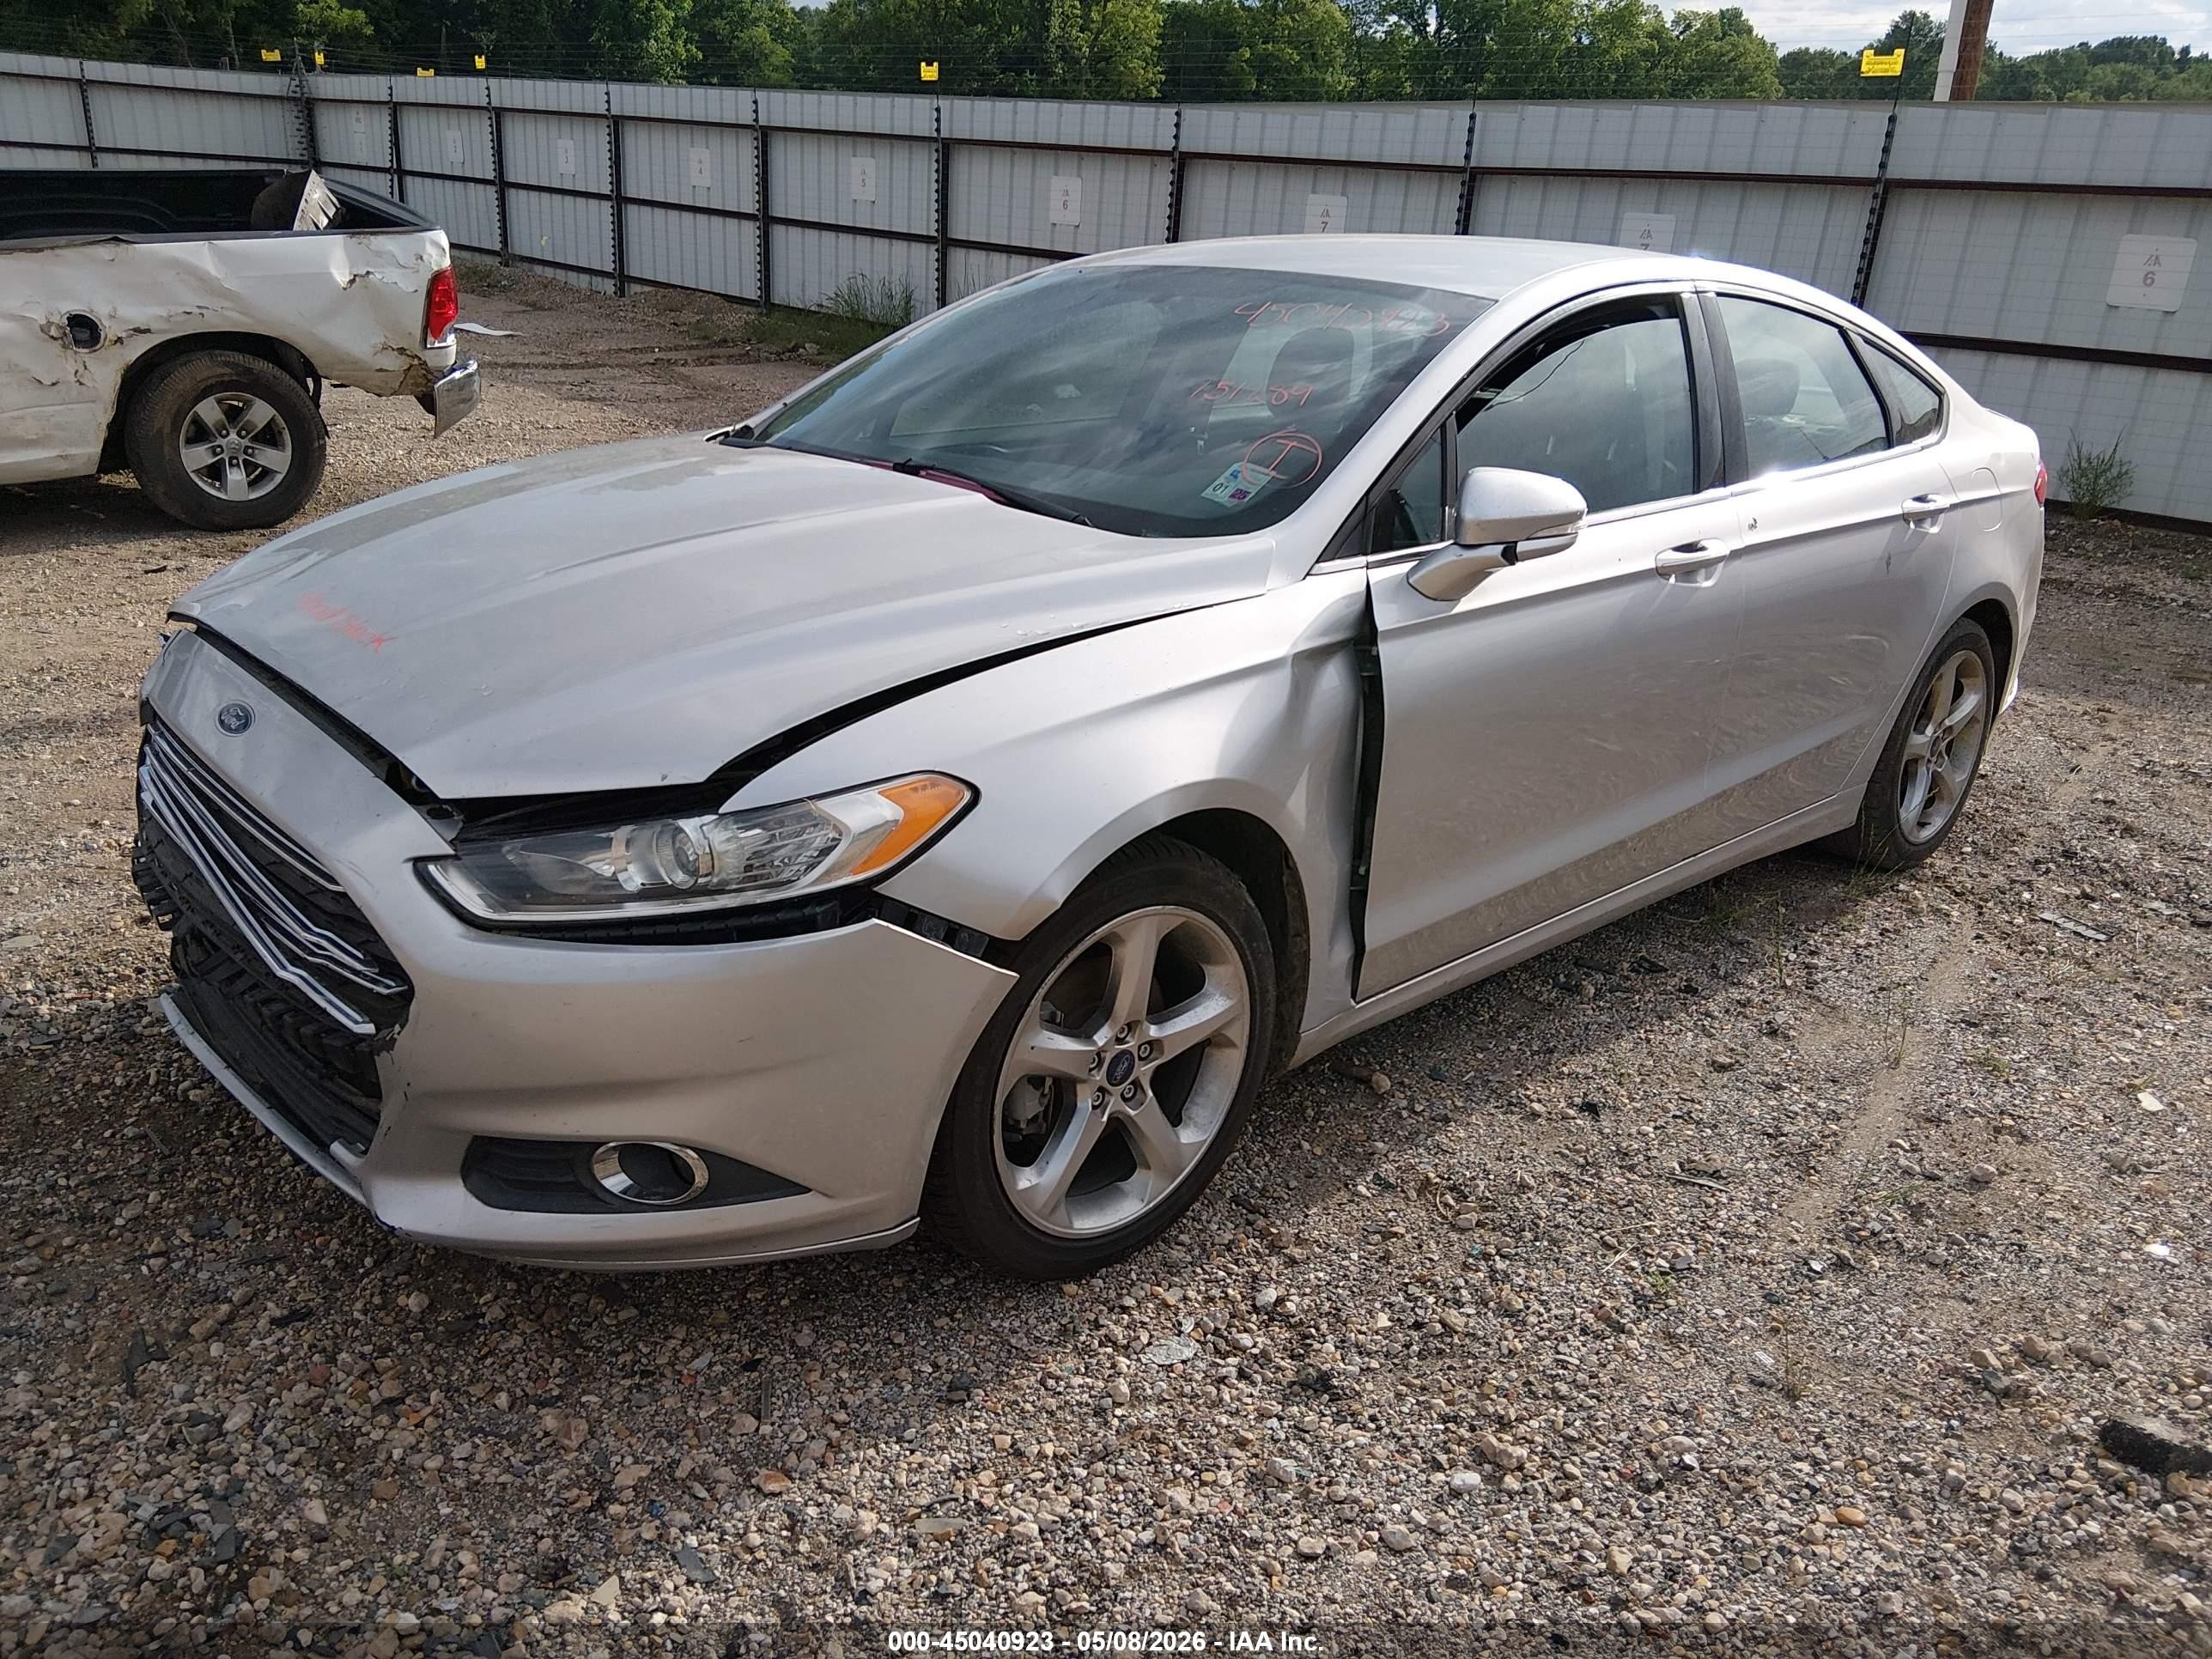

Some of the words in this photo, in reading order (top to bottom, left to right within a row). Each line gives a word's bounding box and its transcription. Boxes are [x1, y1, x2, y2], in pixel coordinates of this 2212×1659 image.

[1062, 199, 1068, 210] 6
[1321, 221, 1328, 233] 7
[2142, 270, 2156, 288] 6
[220, 707, 246, 730] Ford
